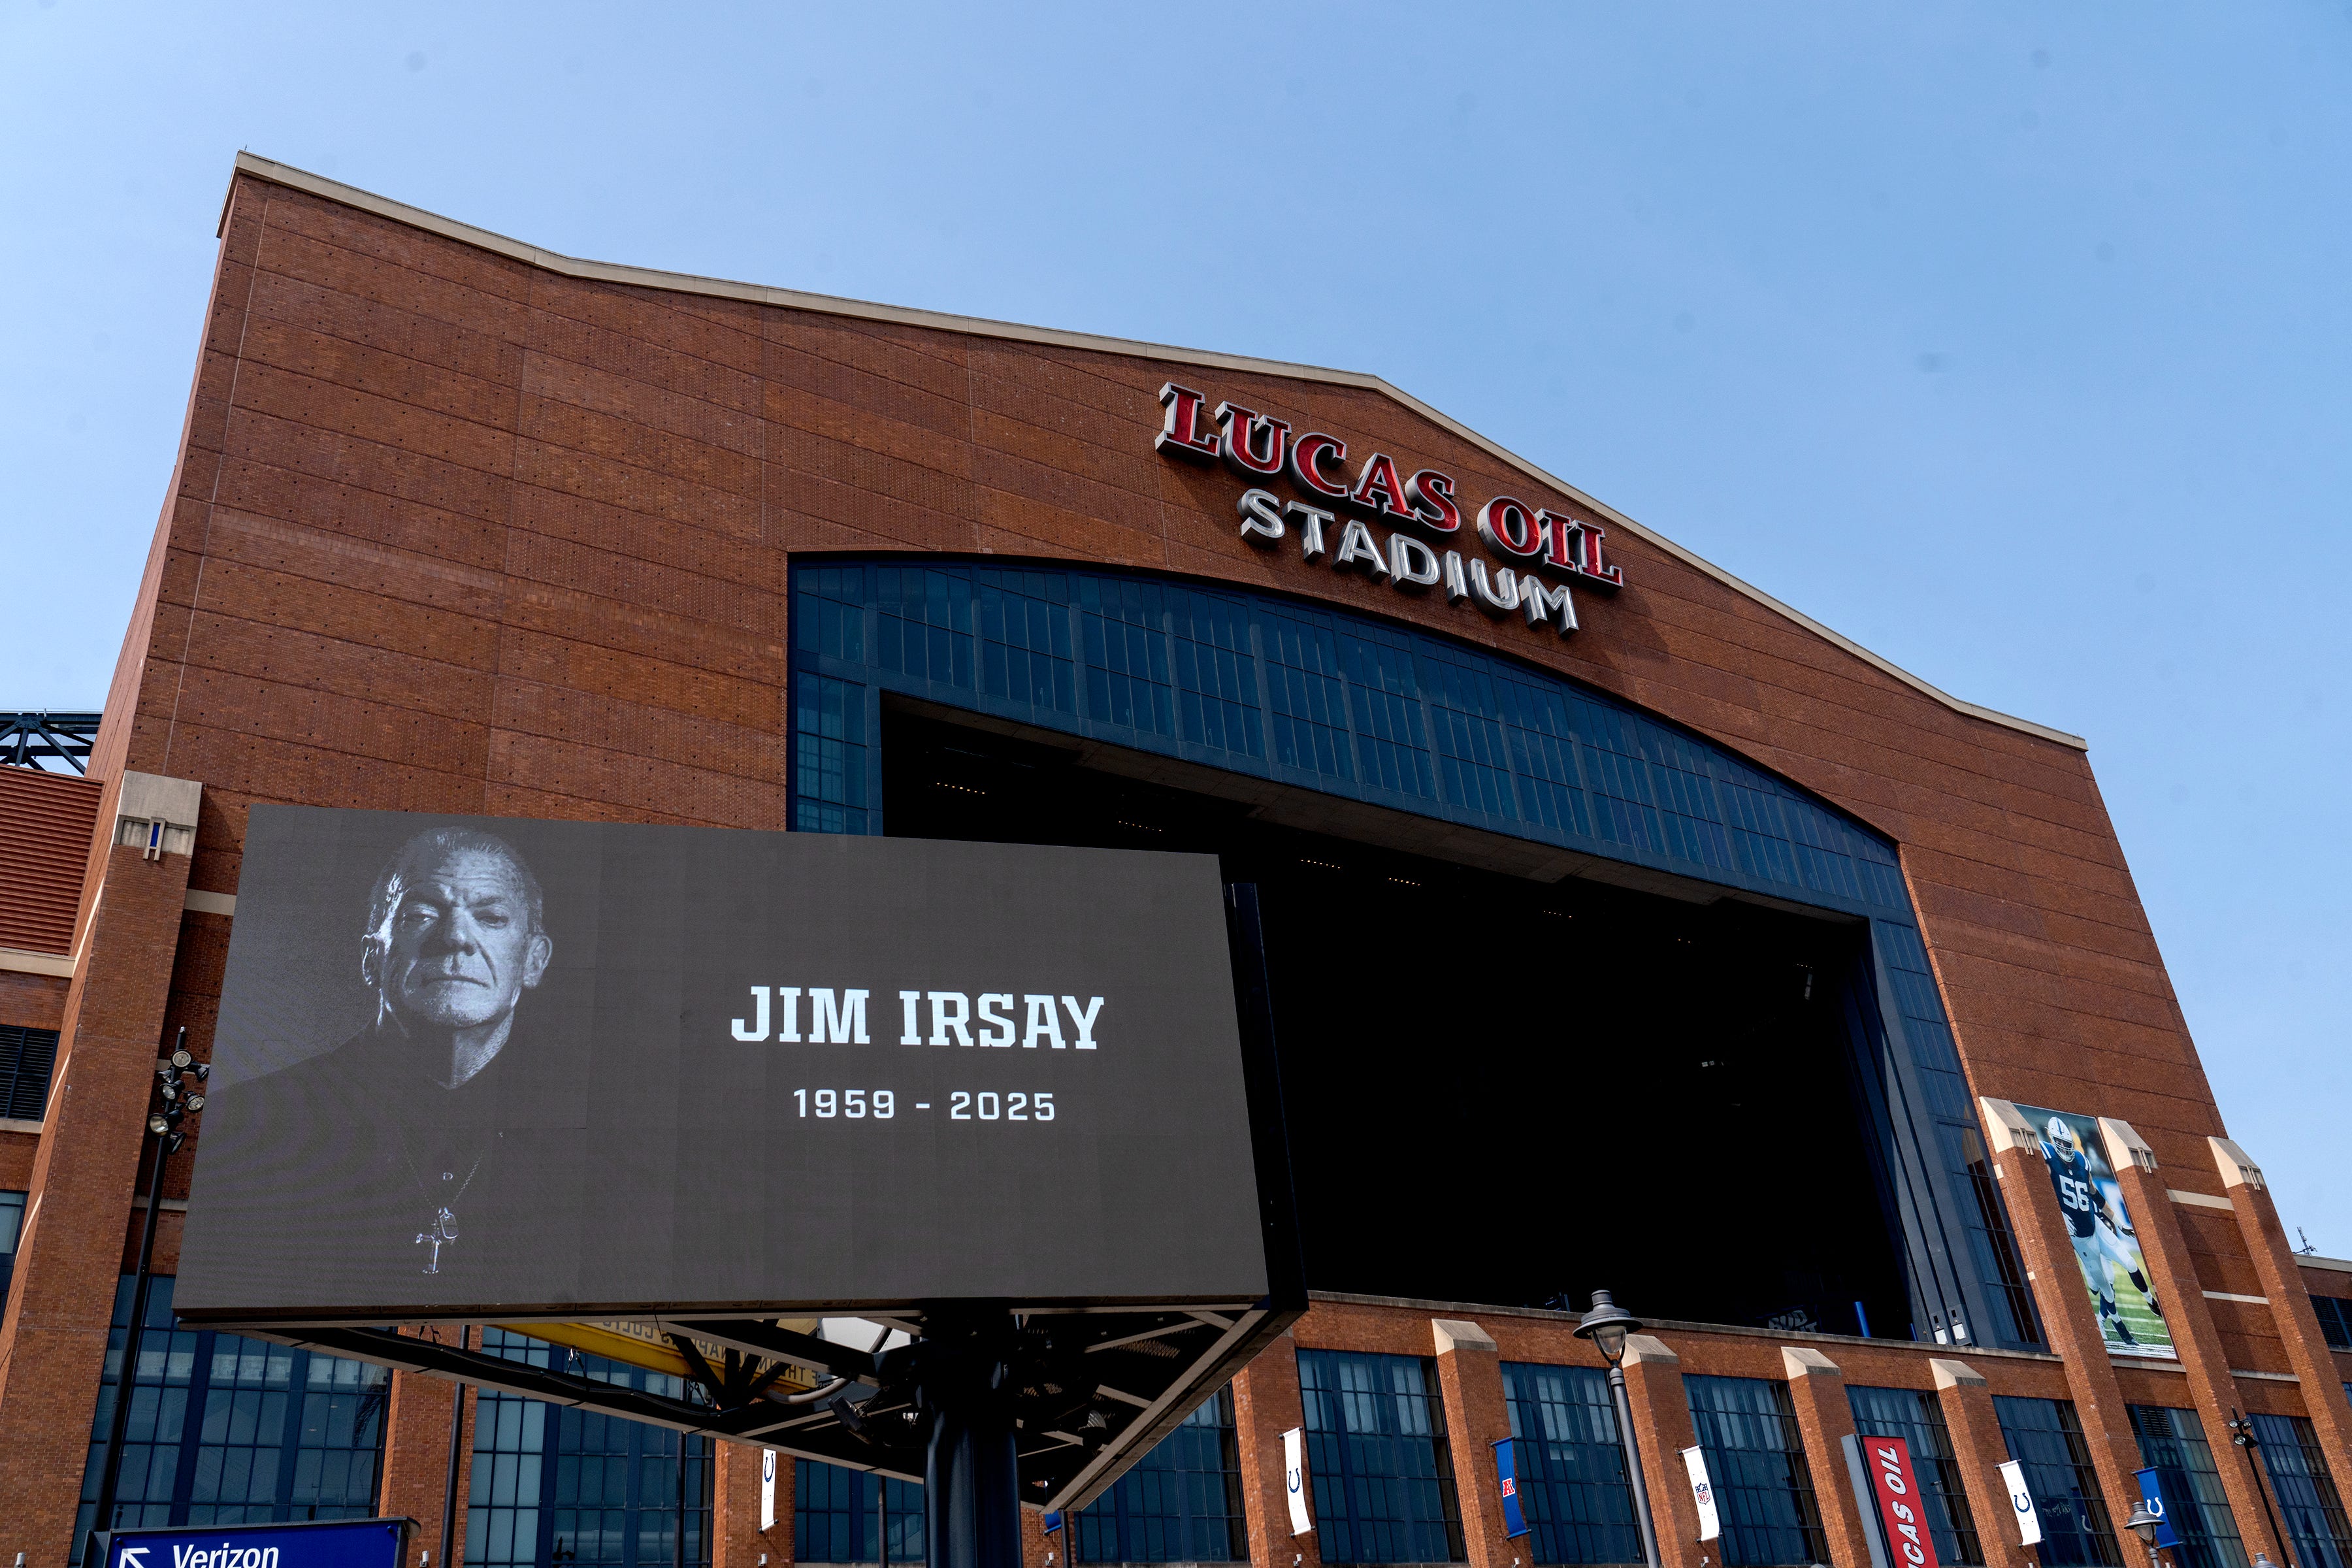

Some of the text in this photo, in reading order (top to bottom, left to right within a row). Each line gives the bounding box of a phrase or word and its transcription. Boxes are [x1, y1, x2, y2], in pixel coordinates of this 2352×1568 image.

[1155, 381, 1624, 592] LUCAS OIL
[1236, 488, 1580, 636] STADIUM
[731, 985, 1105, 1050] JIM IRSAY
[793, 1088, 895, 1119] 1959
[951, 1091, 1055, 1121] 2025
[2059, 1174, 2090, 1212] 56
[1768, 1309, 1808, 1330] BUD
[1698, 1491, 1709, 1503] NFL
[1877, 1446, 1925, 1568] CAS OIL
[172, 1542, 280, 1568] Verizon
